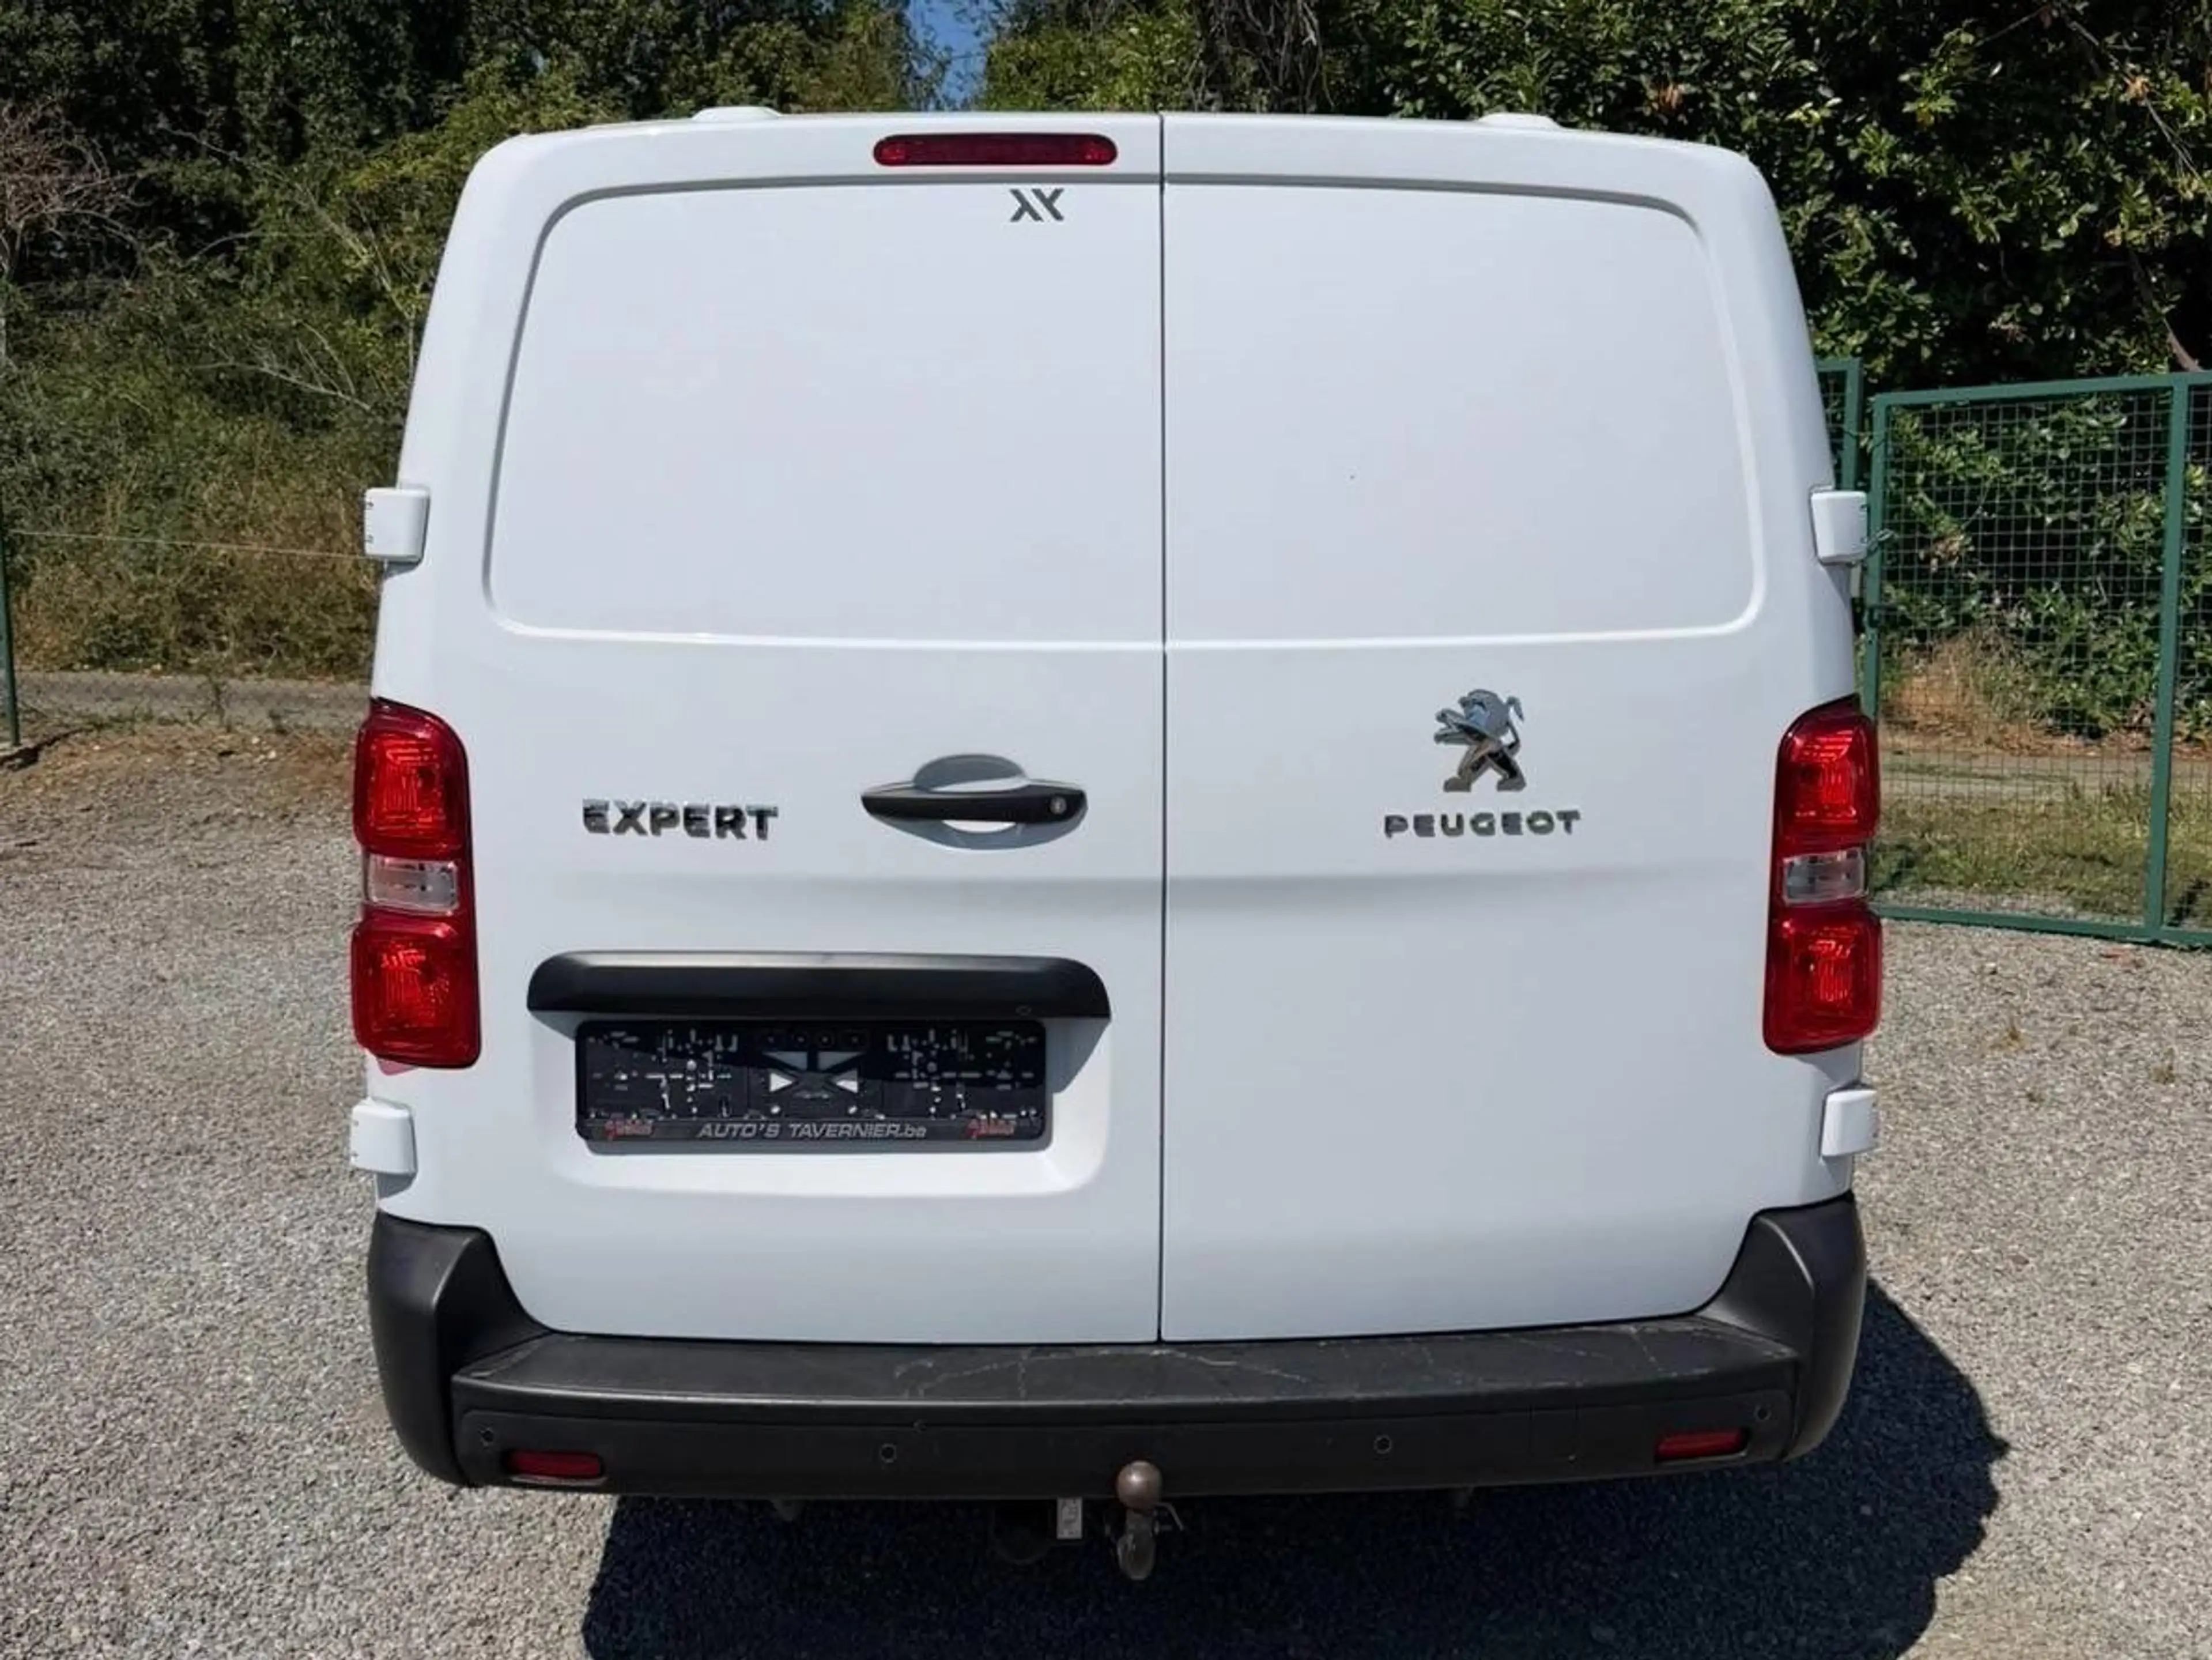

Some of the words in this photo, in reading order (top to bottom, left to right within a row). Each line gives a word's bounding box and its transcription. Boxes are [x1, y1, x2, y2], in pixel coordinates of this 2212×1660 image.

[582, 799, 779, 841] EXPERT
[1384, 810, 1581, 839] PEUGEOT
[698, 1123, 781, 1139] AUTO'S
[787, 1123, 927, 1139] TAVERNIER.be
